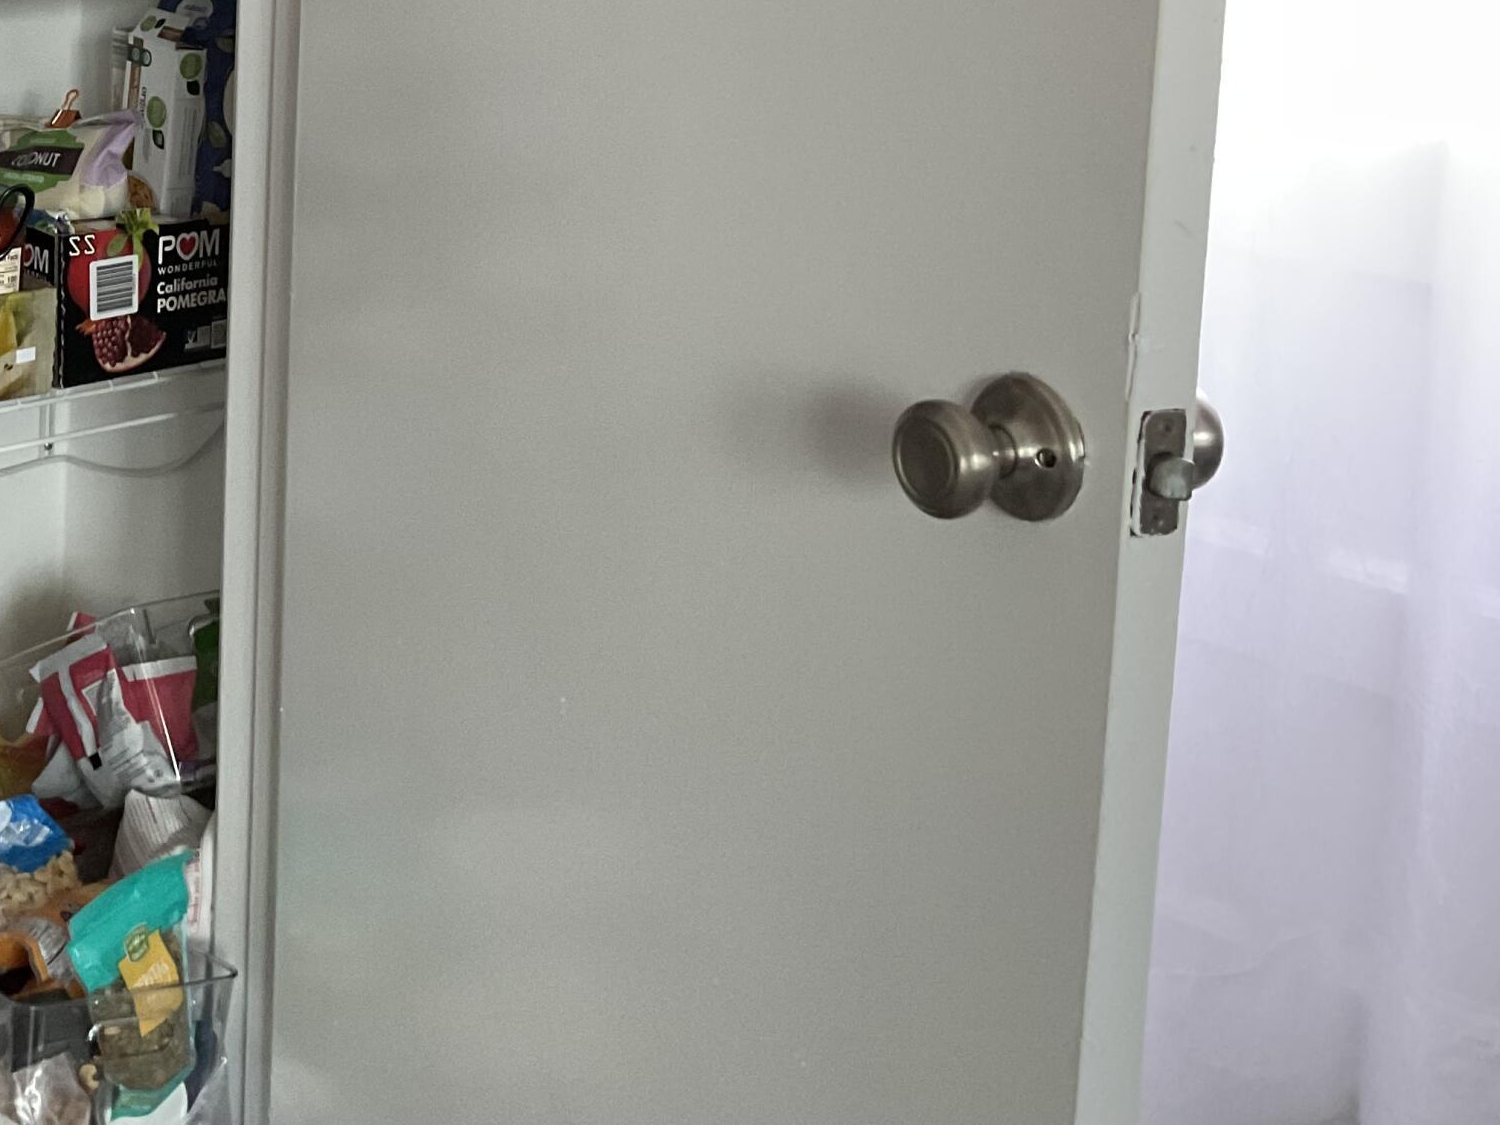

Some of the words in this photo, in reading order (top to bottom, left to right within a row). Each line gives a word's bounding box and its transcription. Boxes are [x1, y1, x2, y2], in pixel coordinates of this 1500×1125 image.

[158, 227, 220, 265] POM
[157, 259, 218, 275] WONDERFUL
[157, 273, 218, 294] California
[157, 288, 227, 314] POMEGRA
